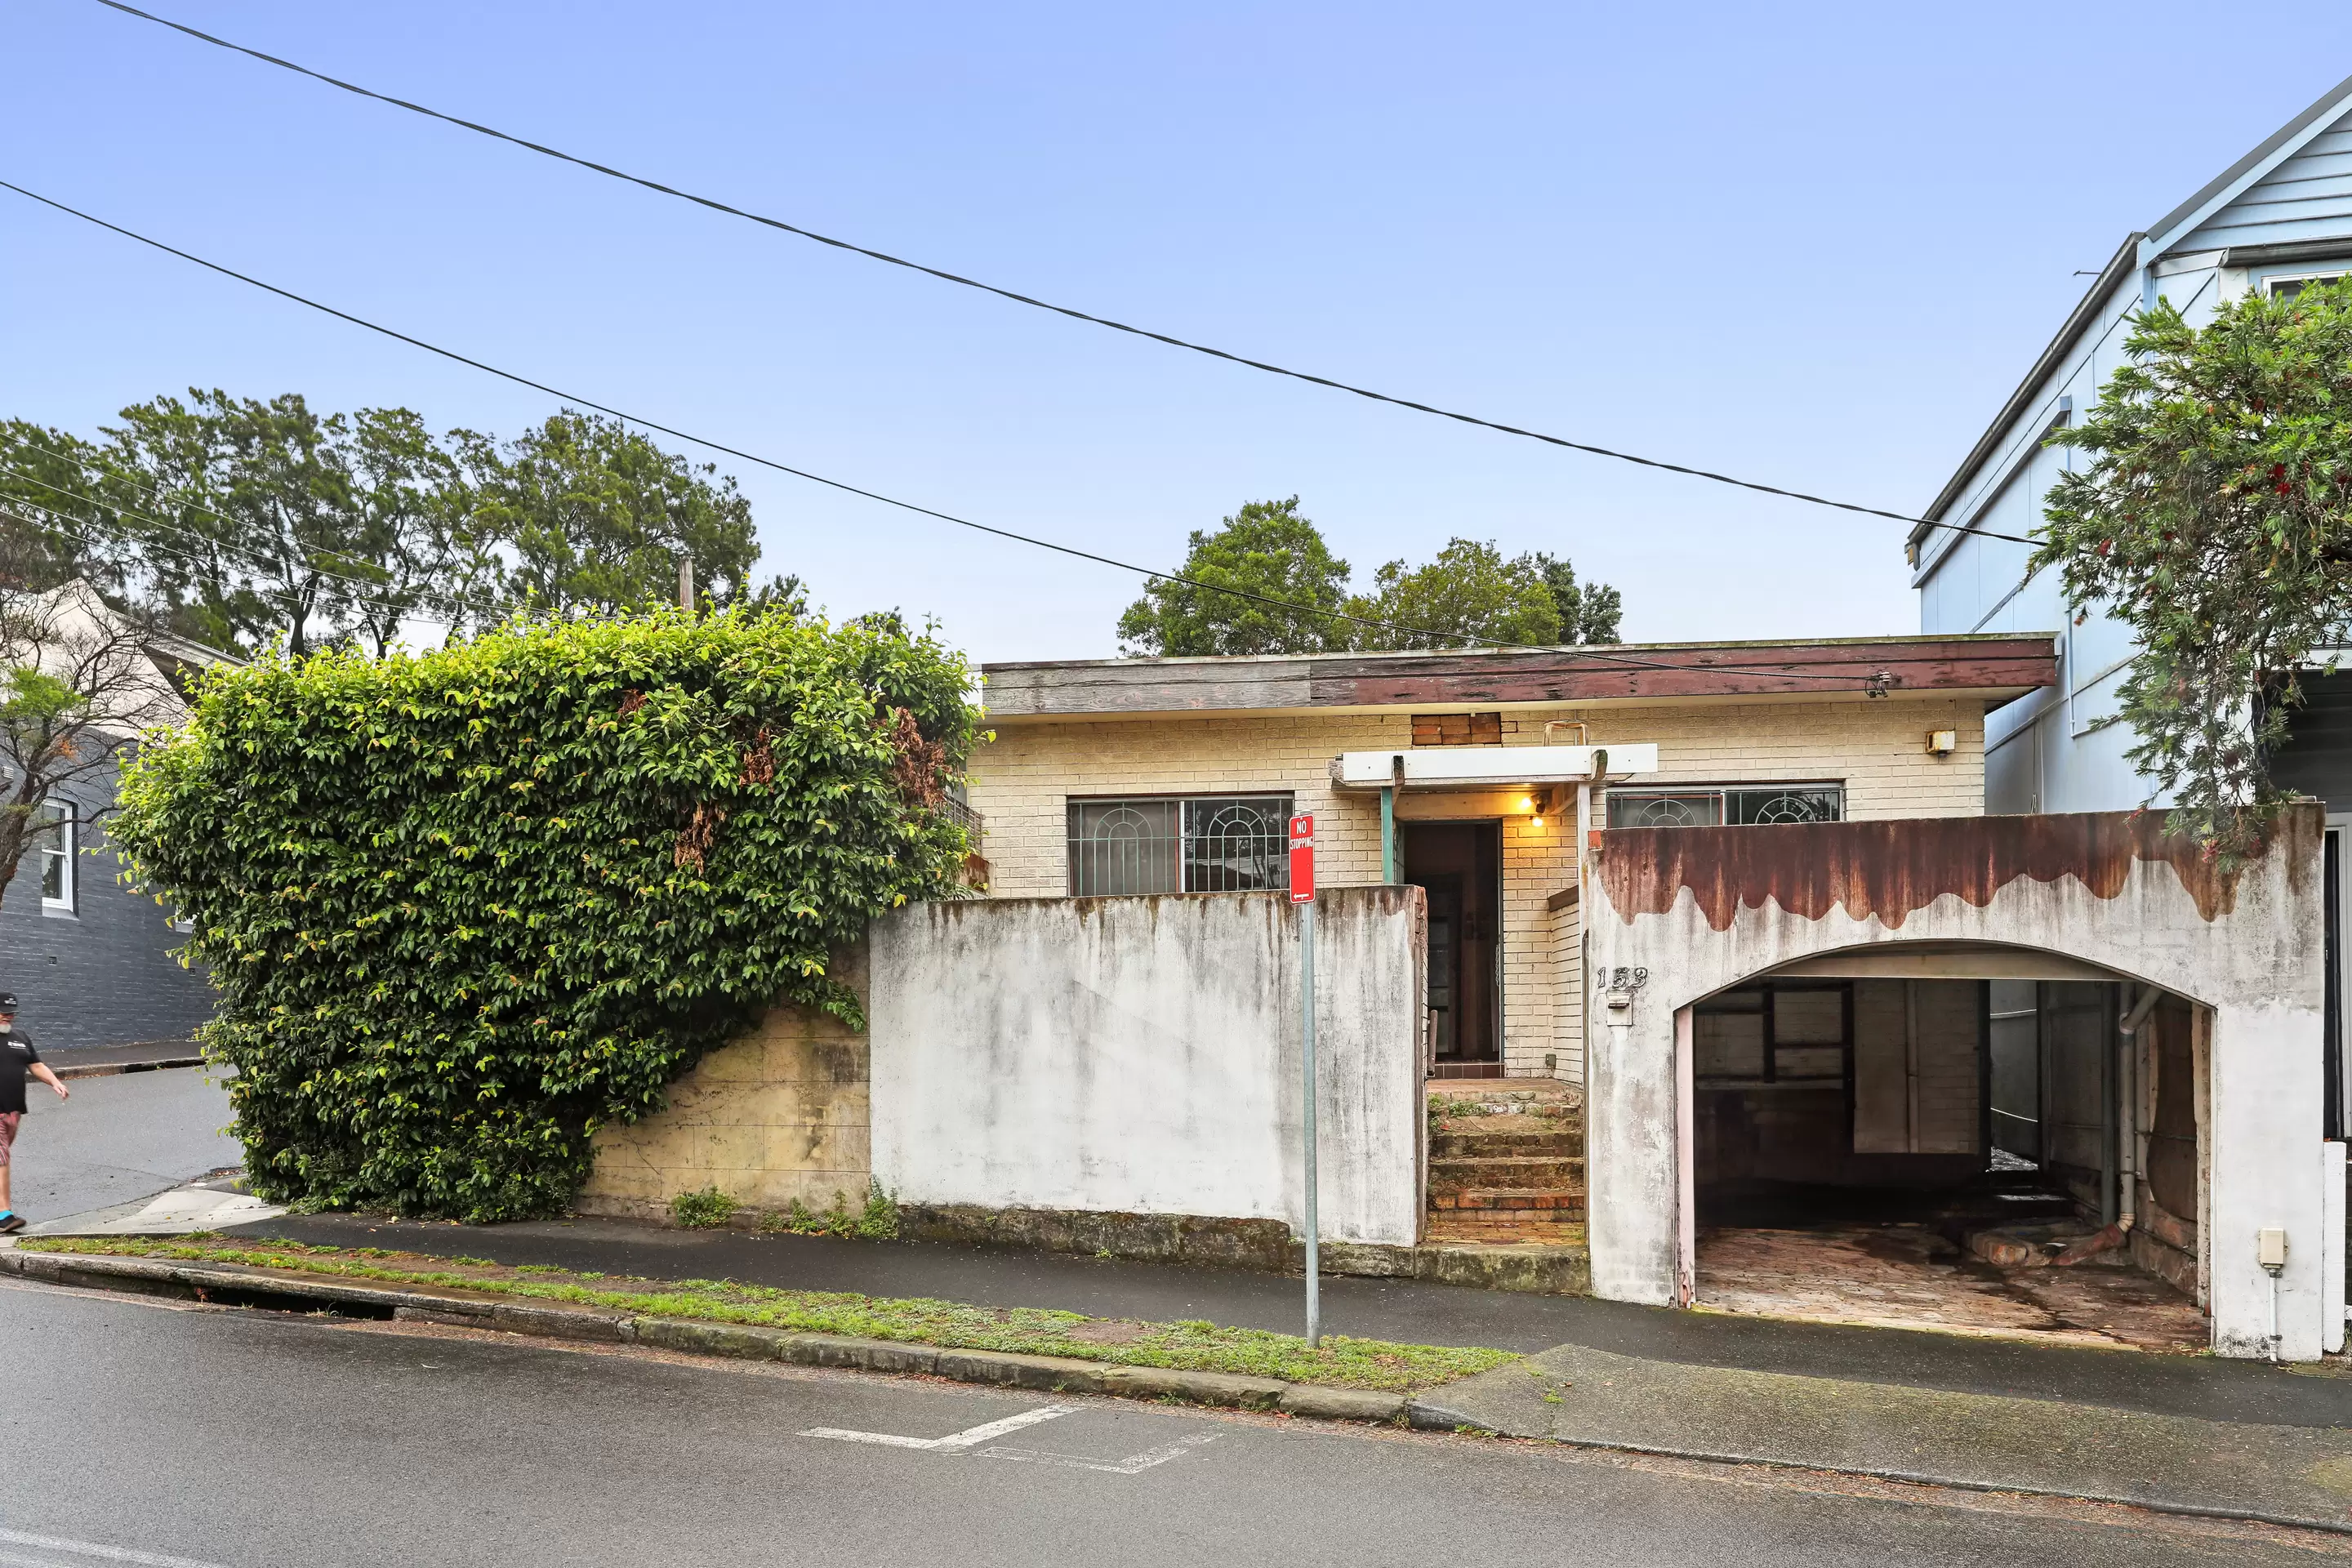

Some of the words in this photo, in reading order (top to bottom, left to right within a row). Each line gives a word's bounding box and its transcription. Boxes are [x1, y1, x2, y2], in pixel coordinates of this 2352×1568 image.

[1296, 820, 1307, 835] NO
[1290, 835, 1313, 850] STOPPING
[1597, 966, 1648, 989] 153
